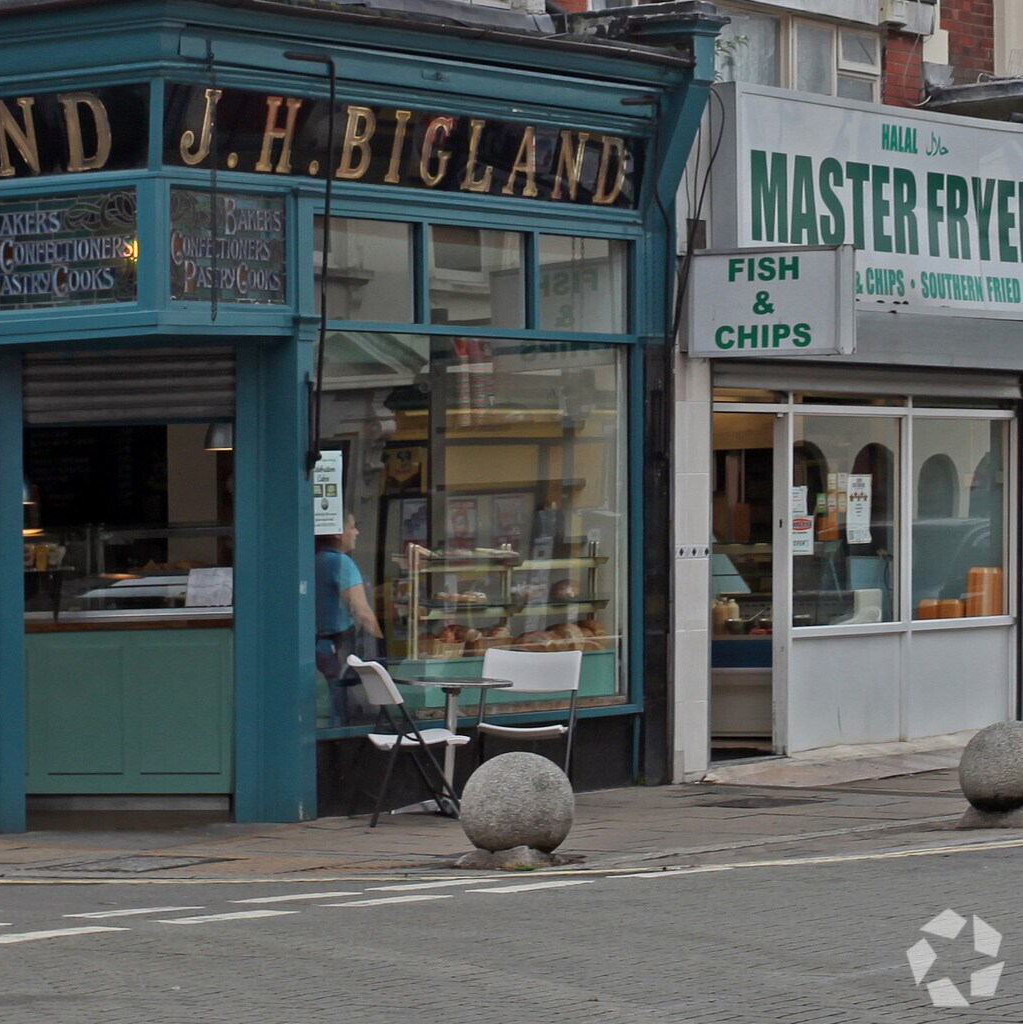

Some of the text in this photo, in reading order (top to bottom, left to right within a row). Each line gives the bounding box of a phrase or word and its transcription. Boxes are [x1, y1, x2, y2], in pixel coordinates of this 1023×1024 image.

[882, 123, 918, 154] HALAL
[926, 131, 949, 157] حلال
[751, 149, 1023, 263] MASTER FRYE
[171, 230, 270, 266] CONFETIONERS
[728, 256, 799, 282] FISH
[865, 266, 905, 297] CHIPS
[920, 270, 984, 302] SOUTHERN
[986, 276, 1021, 304] FRIED
[752, 291, 775, 315] &
[714, 323, 811, 349] CHIPS
